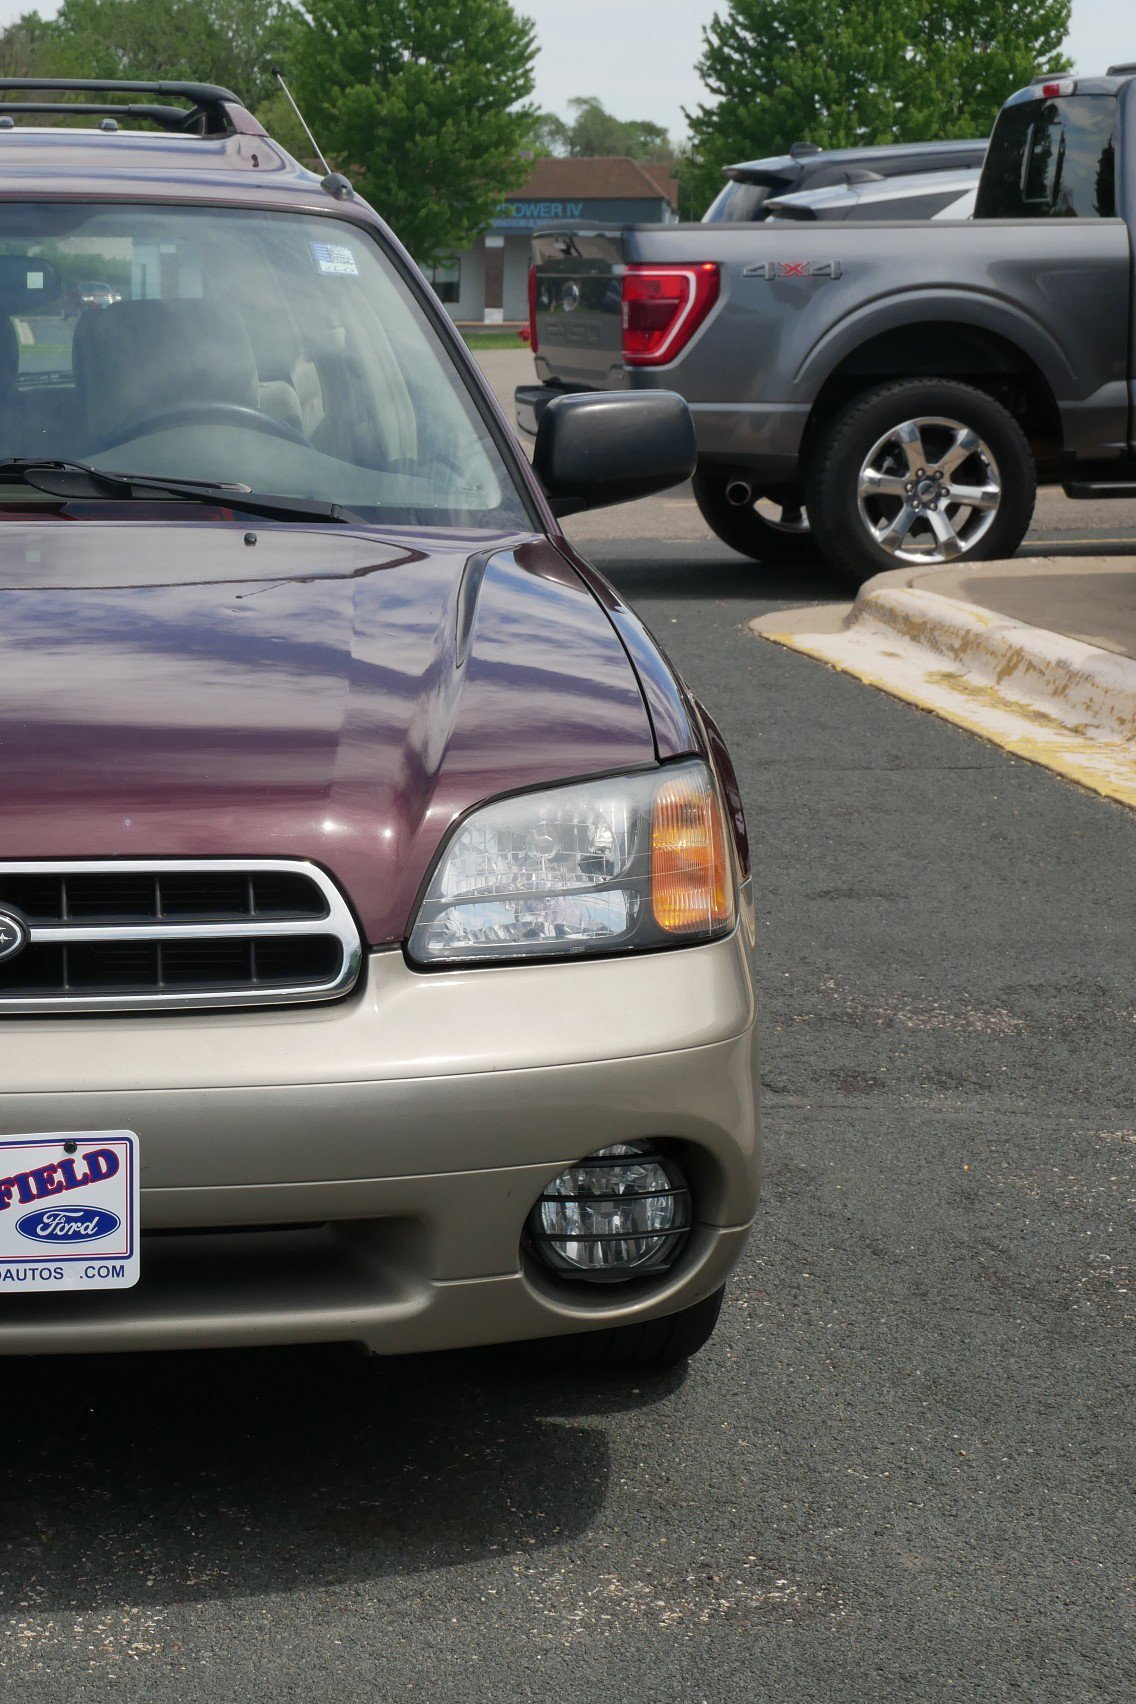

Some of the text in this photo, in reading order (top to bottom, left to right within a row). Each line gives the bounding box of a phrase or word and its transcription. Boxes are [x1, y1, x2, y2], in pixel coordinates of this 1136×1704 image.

[497, 203, 583, 217] OWER IV
[36, 1210, 99, 1237] Ford
[79, 1264, 126, 1280] .COM
